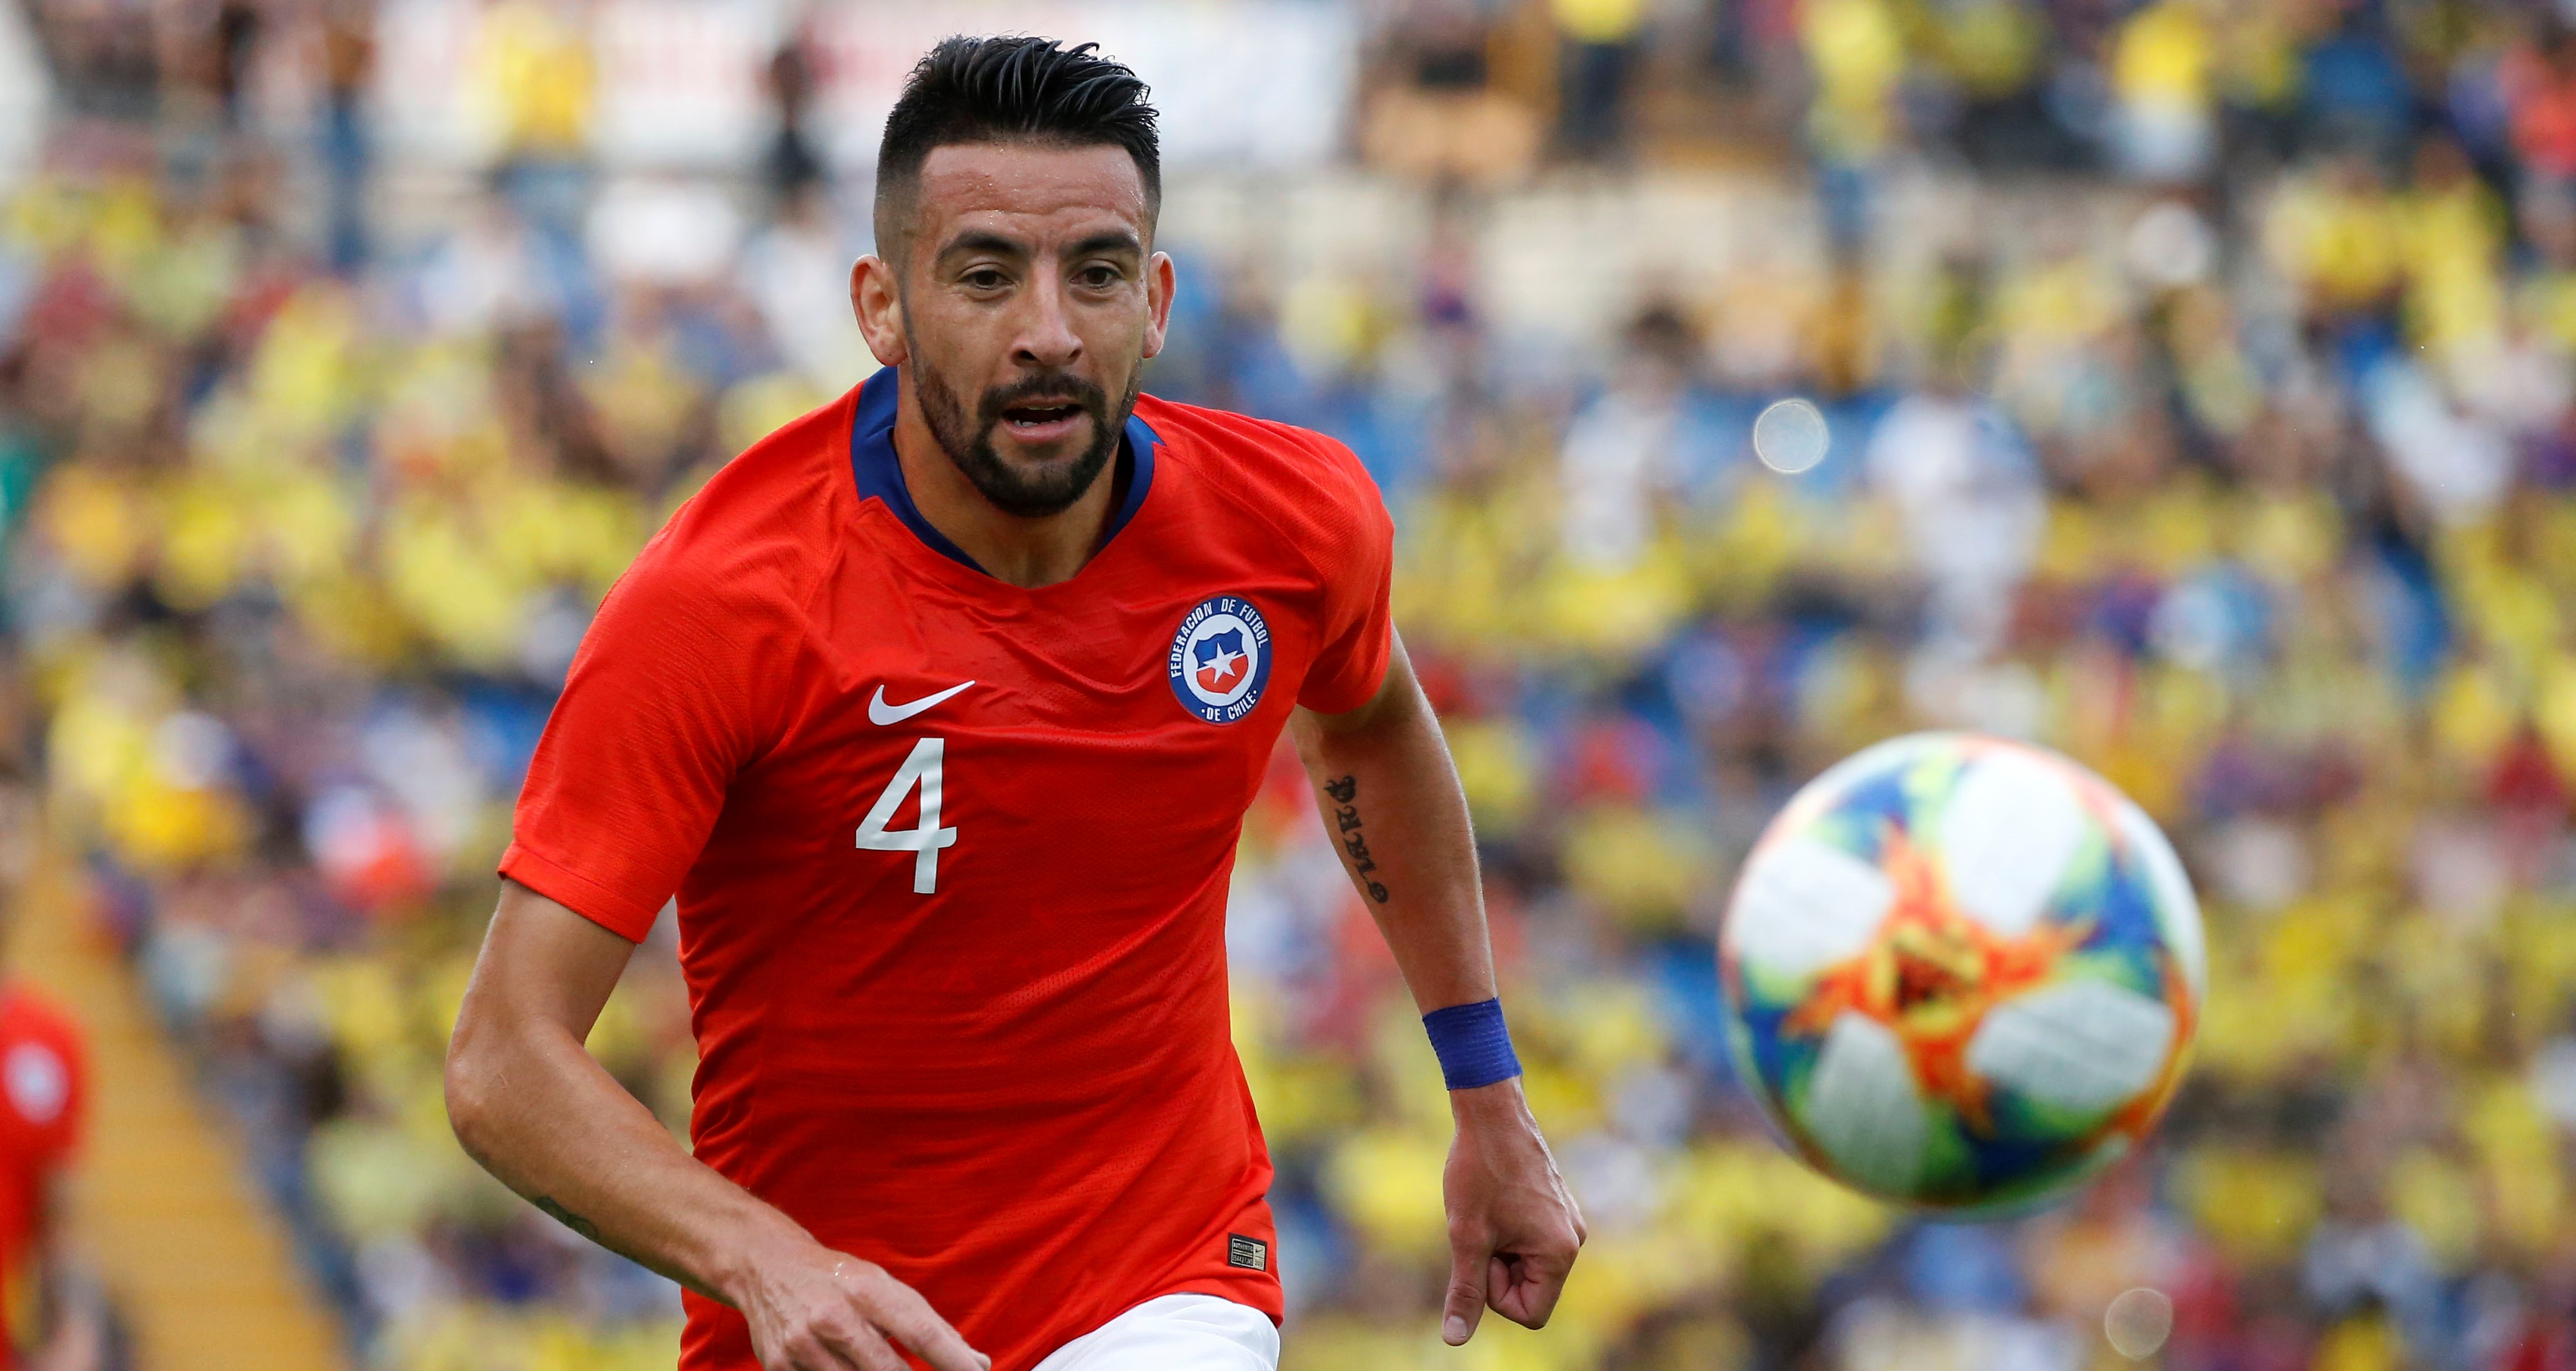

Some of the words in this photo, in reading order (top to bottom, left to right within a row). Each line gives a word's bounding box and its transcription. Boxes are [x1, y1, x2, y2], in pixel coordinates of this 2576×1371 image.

[1170, 602, 1213, 678] FEDERACION
[1220, 598, 1236, 613] DE
[1239, 604, 1269, 649] FUTBOL
[1206, 707, 1221, 722] DE
[1227, 692, 1256, 720] CHILE
[855, 737, 957, 894] 4
